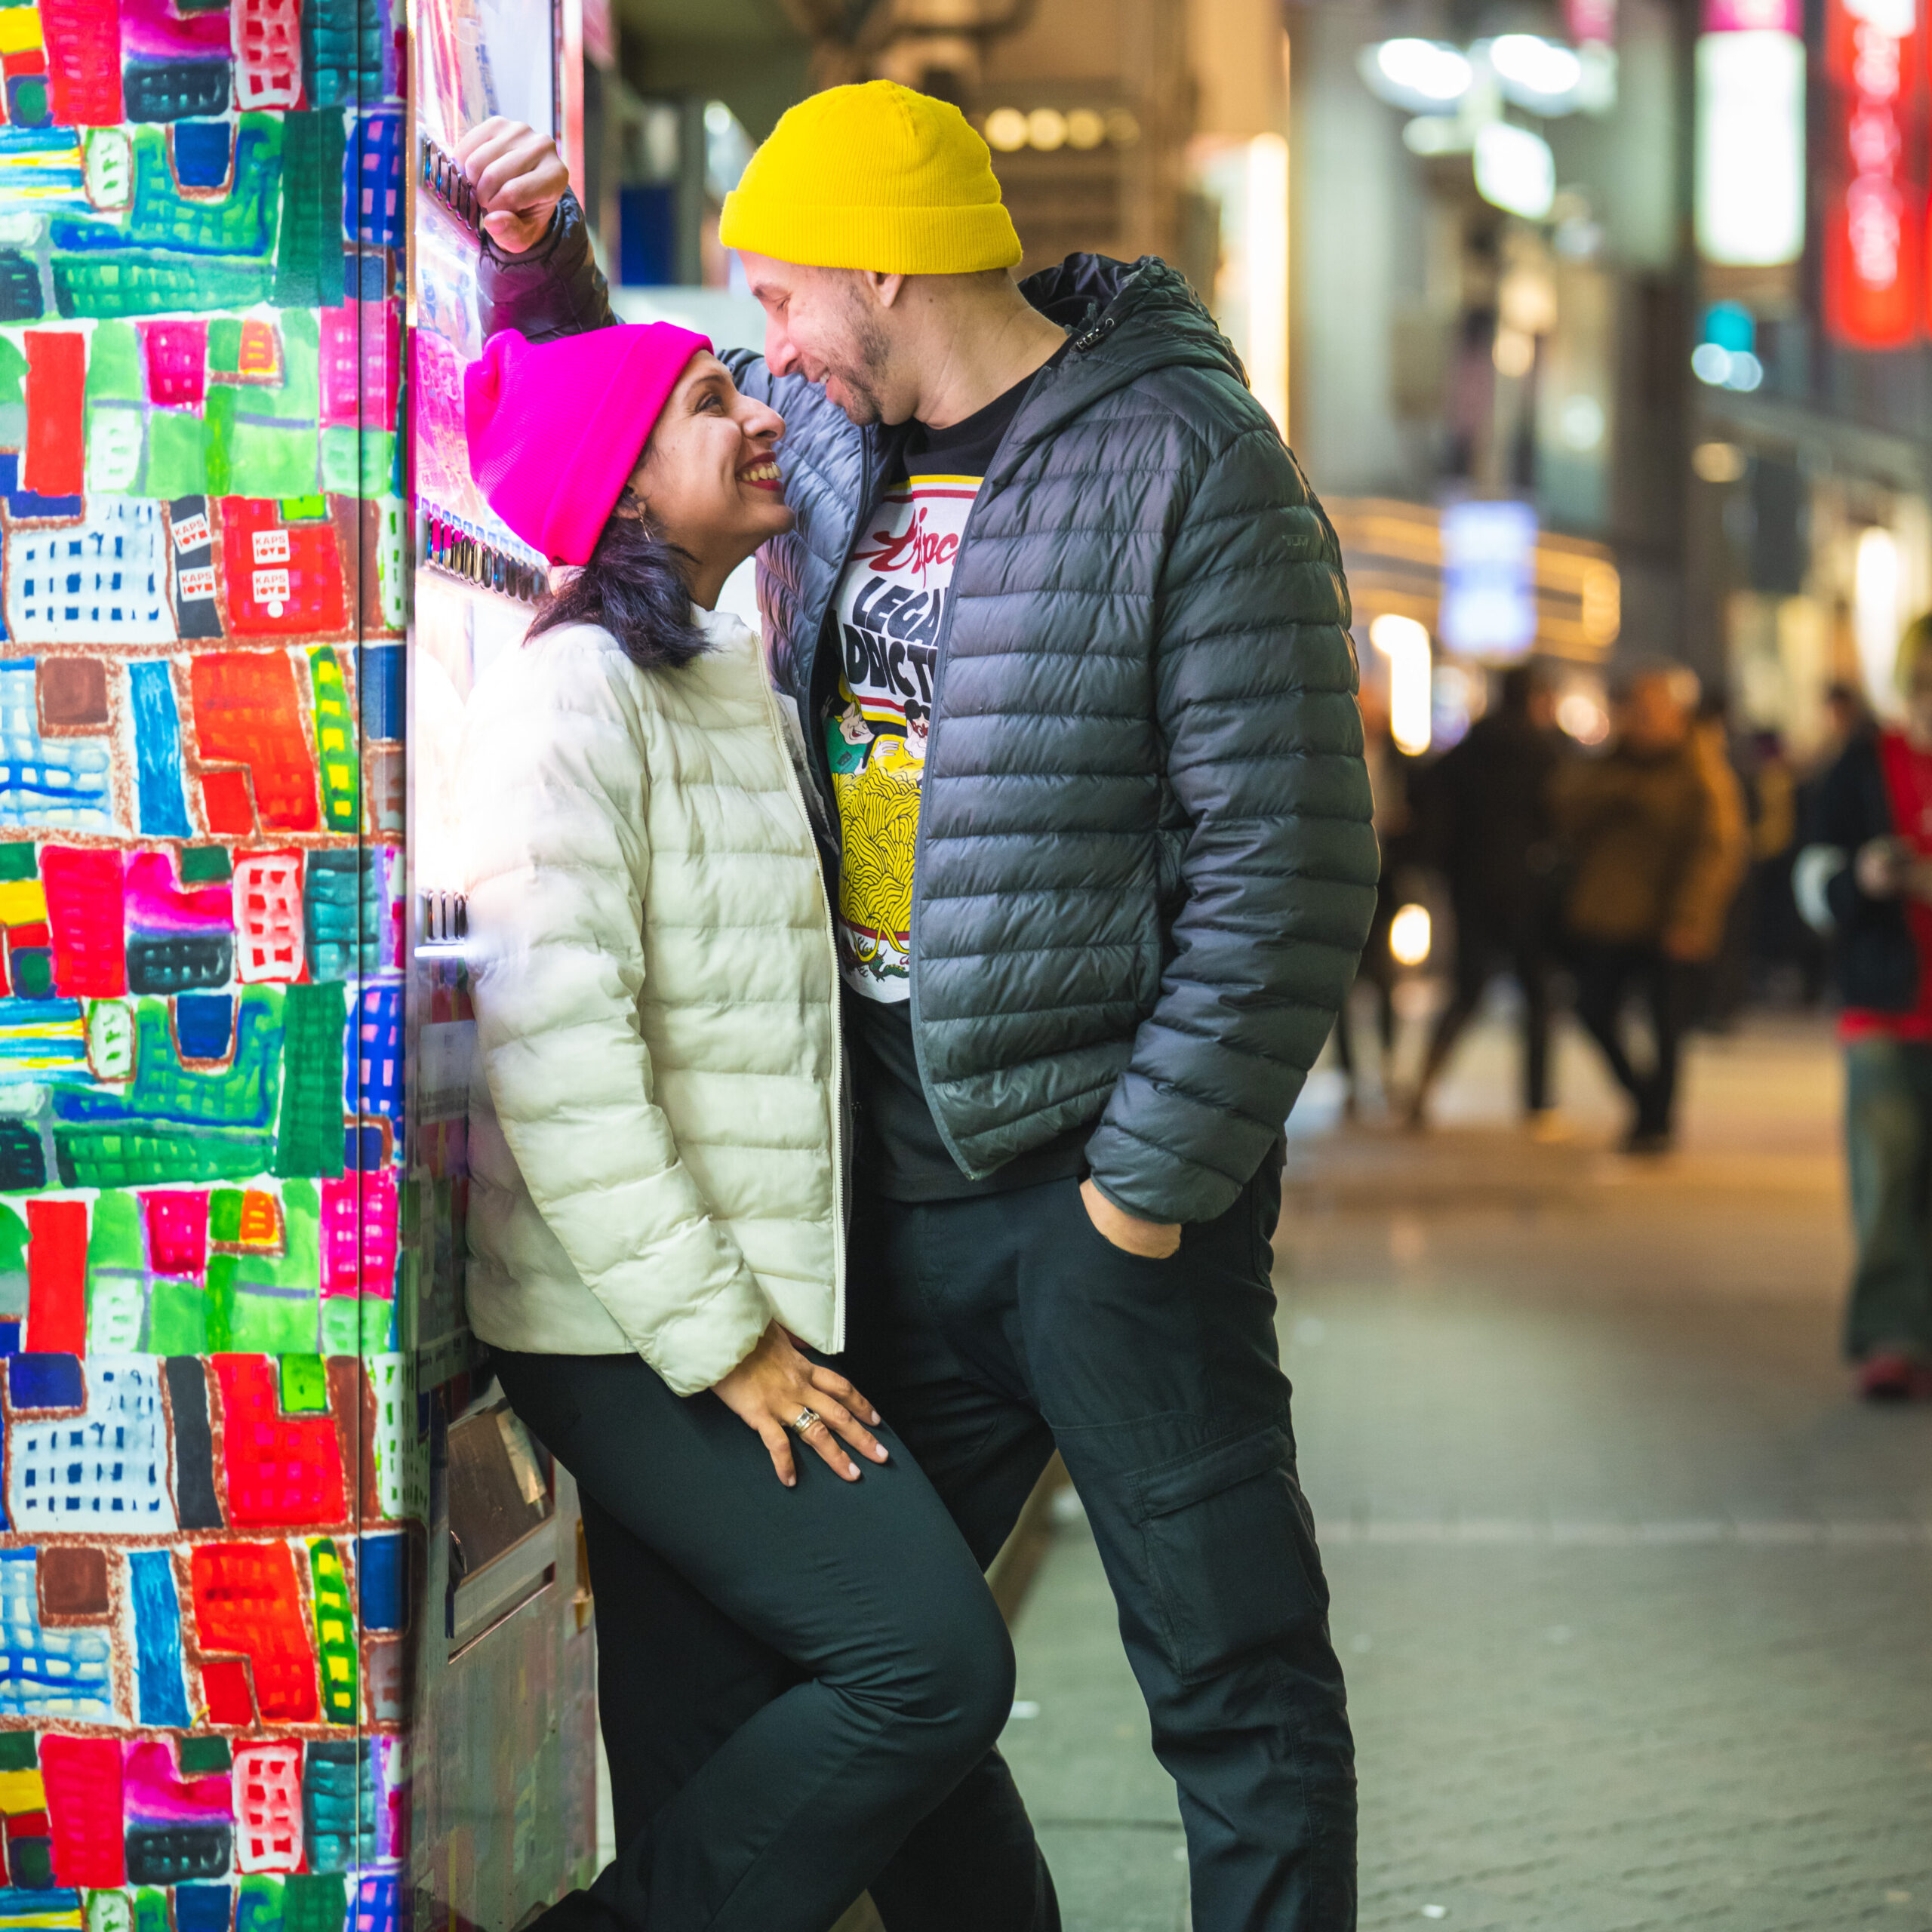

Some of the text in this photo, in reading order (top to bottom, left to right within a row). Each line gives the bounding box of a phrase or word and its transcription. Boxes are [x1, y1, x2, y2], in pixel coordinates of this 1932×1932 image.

[175, 519, 204, 537] KAPS
[256, 536, 285, 545] KAPS
[182, 572, 211, 583] KAPS
[256, 575, 285, 584] KAPS
[852, 576, 949, 647] LEGA
